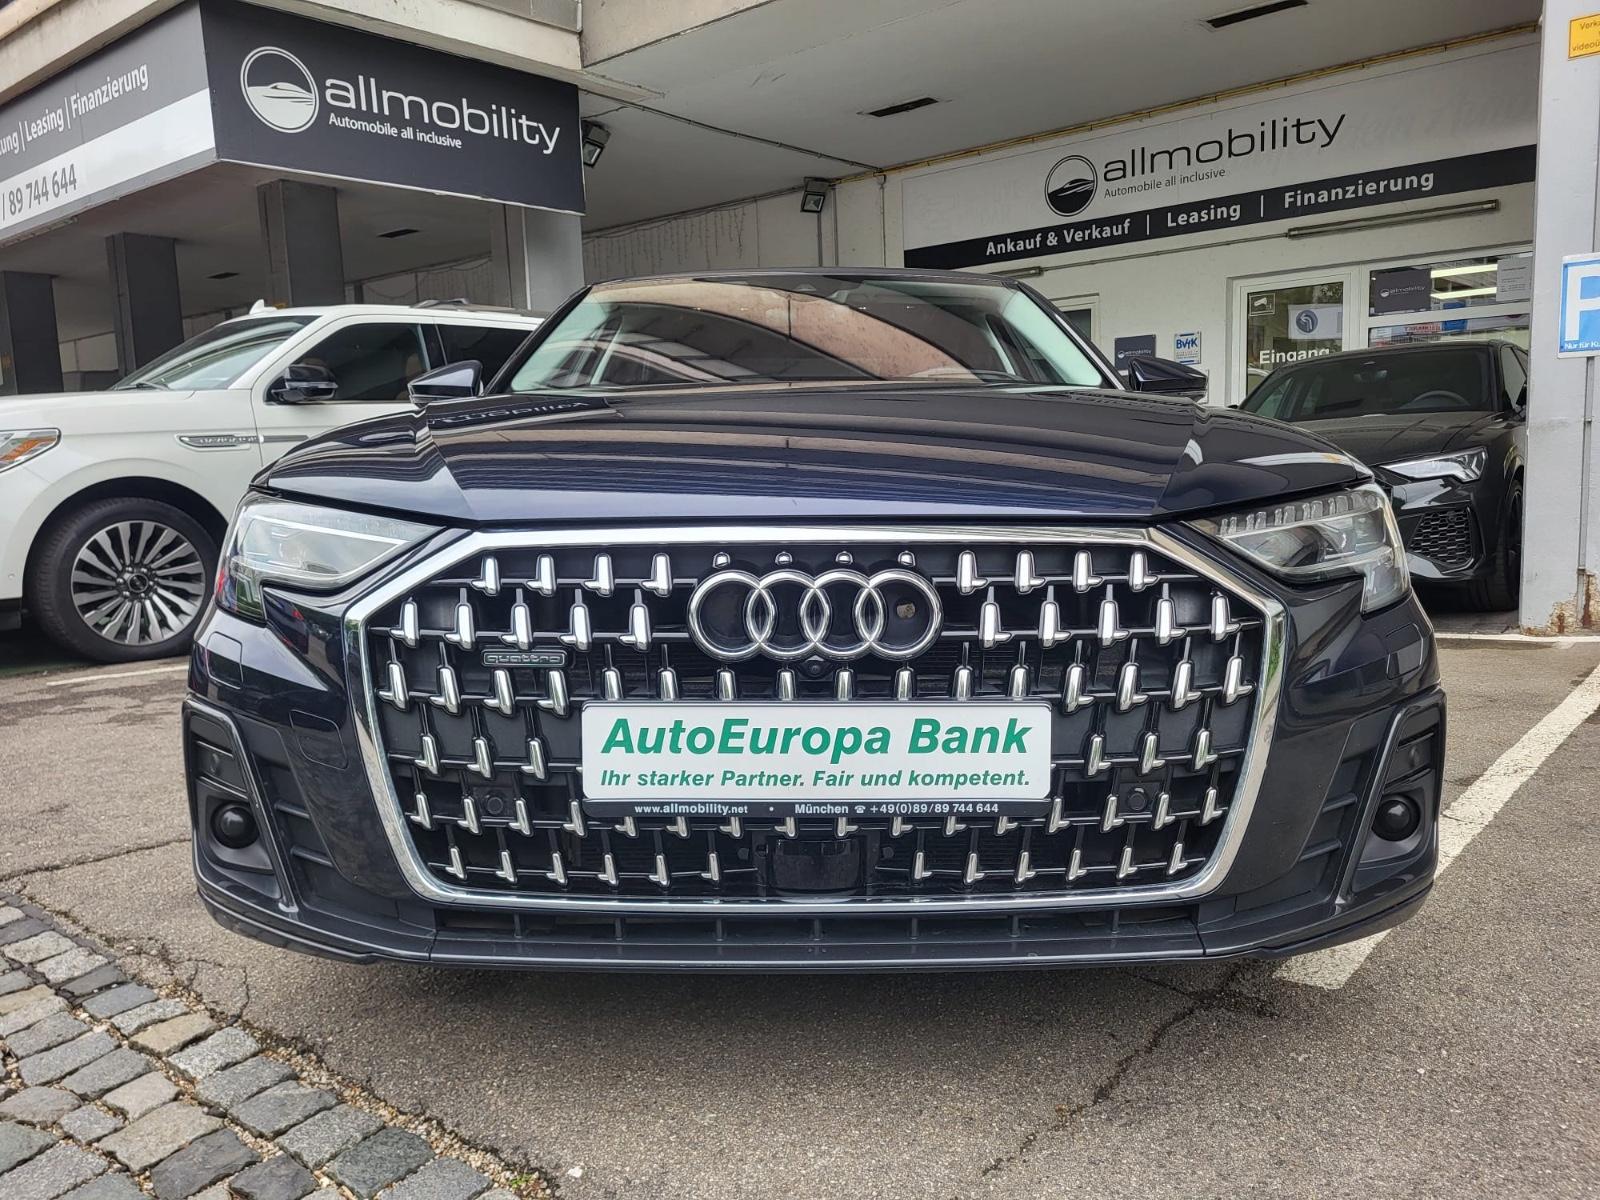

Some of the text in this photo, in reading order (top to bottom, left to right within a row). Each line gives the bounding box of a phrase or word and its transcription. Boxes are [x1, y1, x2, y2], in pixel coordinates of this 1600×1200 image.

[0, 63, 149, 155] ung Leasing Finanzierung
[325, 75, 561, 155] allmobility
[328, 113, 463, 149] Automobile all inclusive
[1103, 112, 1346, 182] allmobility
[8, 163, 77, 216] 89 744 644
[1103, 166, 1226, 199] Automobile all inclusive
[986, 170, 1436, 256] Ankauf & Verkauf Leasing Finanzierung
[486, 654, 561, 664] quattro
[600, 718, 1032, 764] AutoEuropa Bank
[600, 769, 1031, 791] Ihr starker Partner. Fair und kompetent.
[634, 803, 749, 816] www.allmobility.net
[794, 802, 849, 815] München
[952, 803, 975, 814] 744
[976, 803, 999, 814] 644
